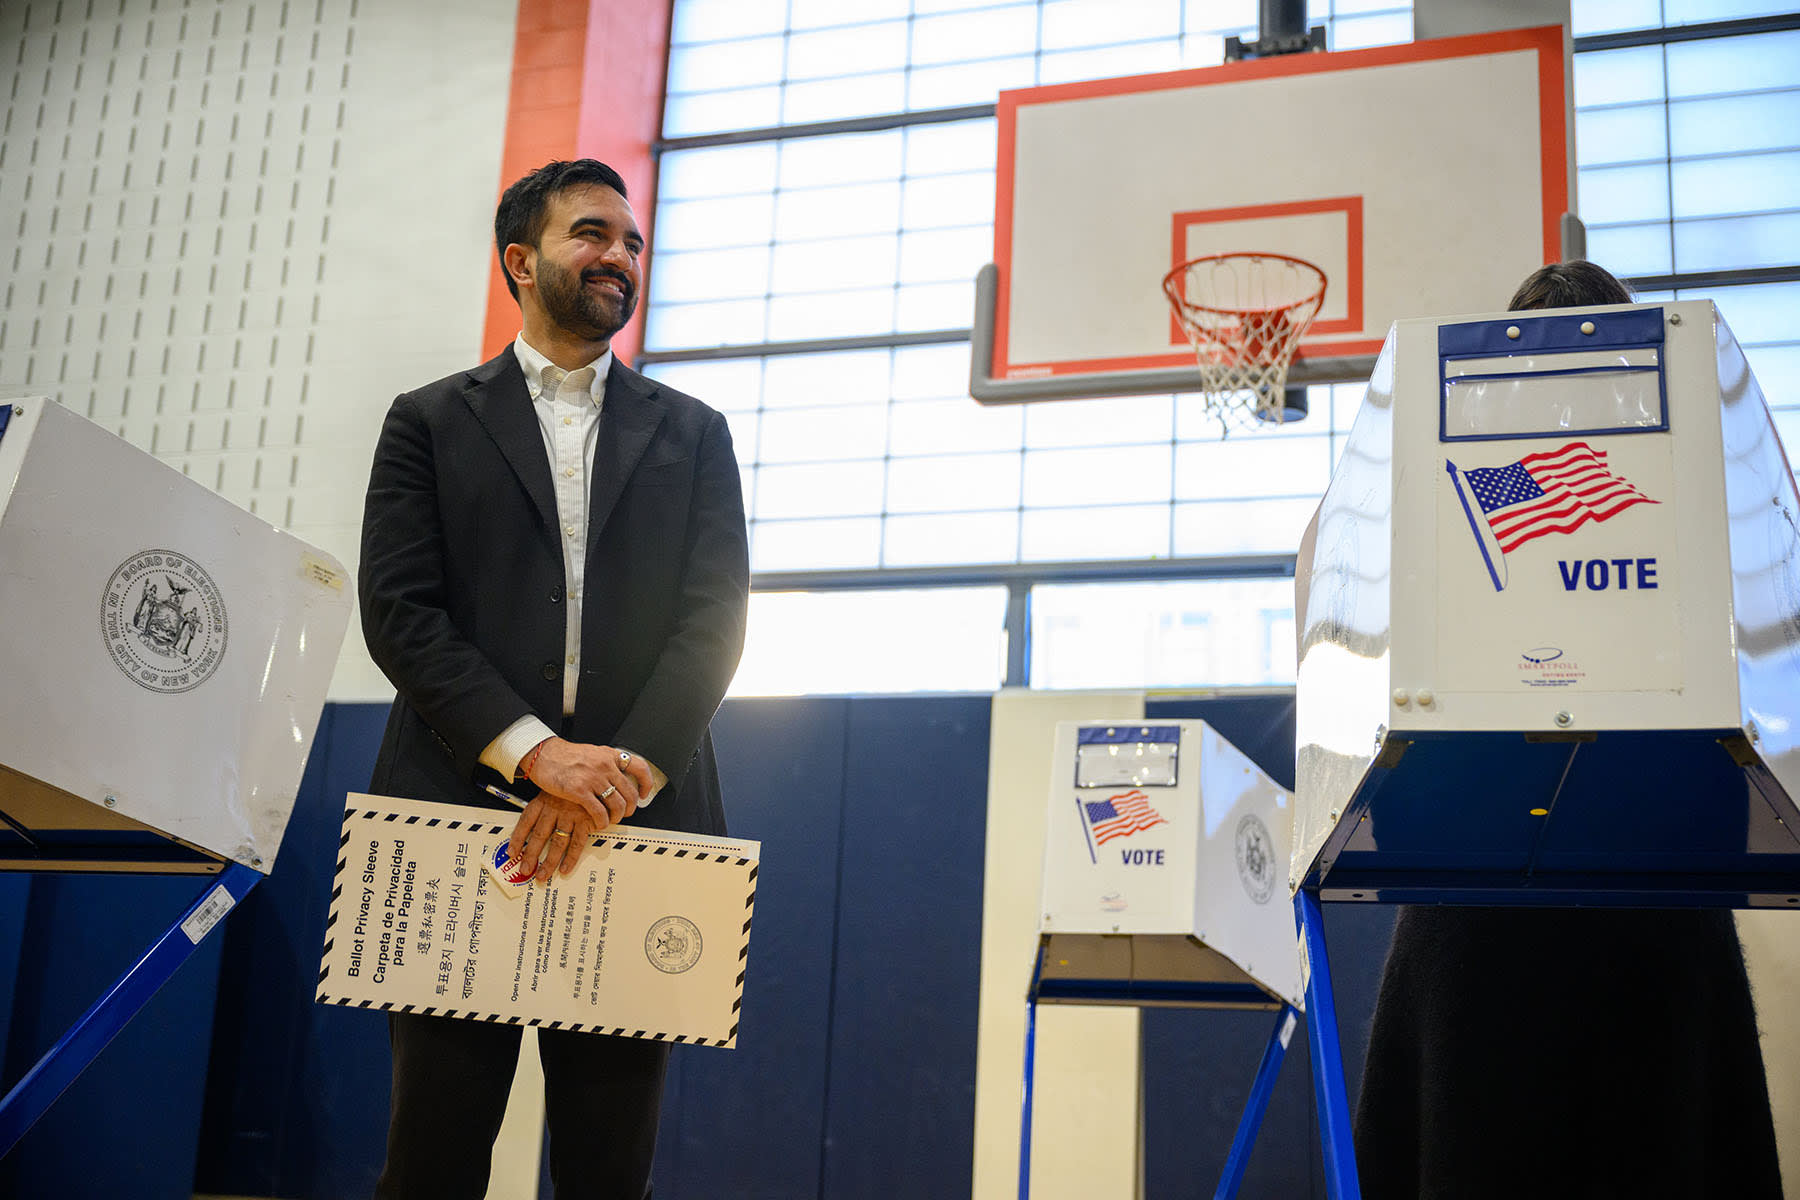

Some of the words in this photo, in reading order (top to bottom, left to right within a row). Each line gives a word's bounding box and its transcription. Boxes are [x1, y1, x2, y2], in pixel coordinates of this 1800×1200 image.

[1558, 557, 1659, 592] VOTE
[107, 591, 120, 608] IN
[121, 555, 163, 582] BOARD
[165, 556, 183, 569] OF
[184, 566, 223, 633] ELECTIONS
[107, 612, 120, 641] THE
[115, 643, 142, 673] CITY
[190, 647, 219, 678] YORK
[140, 669, 159, 683] OF
[161, 672, 190, 687] NEW
[362, 840, 378, 883] Sleeve
[453, 843, 468, 877] 슬리브
[1121, 848, 1165, 866] VOTE
[384, 839, 404, 907] Privacidad
[525, 881, 533, 890] yo
[397, 861, 416, 917] Papeleta
[549, 887, 558, 917] papeleta.
[354, 887, 374, 935] Privacy
[381, 911, 394, 928] de
[443, 883, 463, 943] 프라이버시
[523, 891, 533, 919] marking
[539, 888, 550, 933] instrucciones
[395, 921, 407, 932] la
[468, 900, 484, 954] গোপনীয়তা
[522, 920, 527, 929] on
[548, 919, 553, 927] su
[347, 938, 364, 976] Ballot
[372, 932, 390, 983] Carpeta
[393, 936, 405, 965] para
[515, 930, 526, 970] instructions
[435, 949, 453, 995] 투표용지
[461, 958, 476, 999] ব্যালটের
[510, 983, 519, 1001] Open
